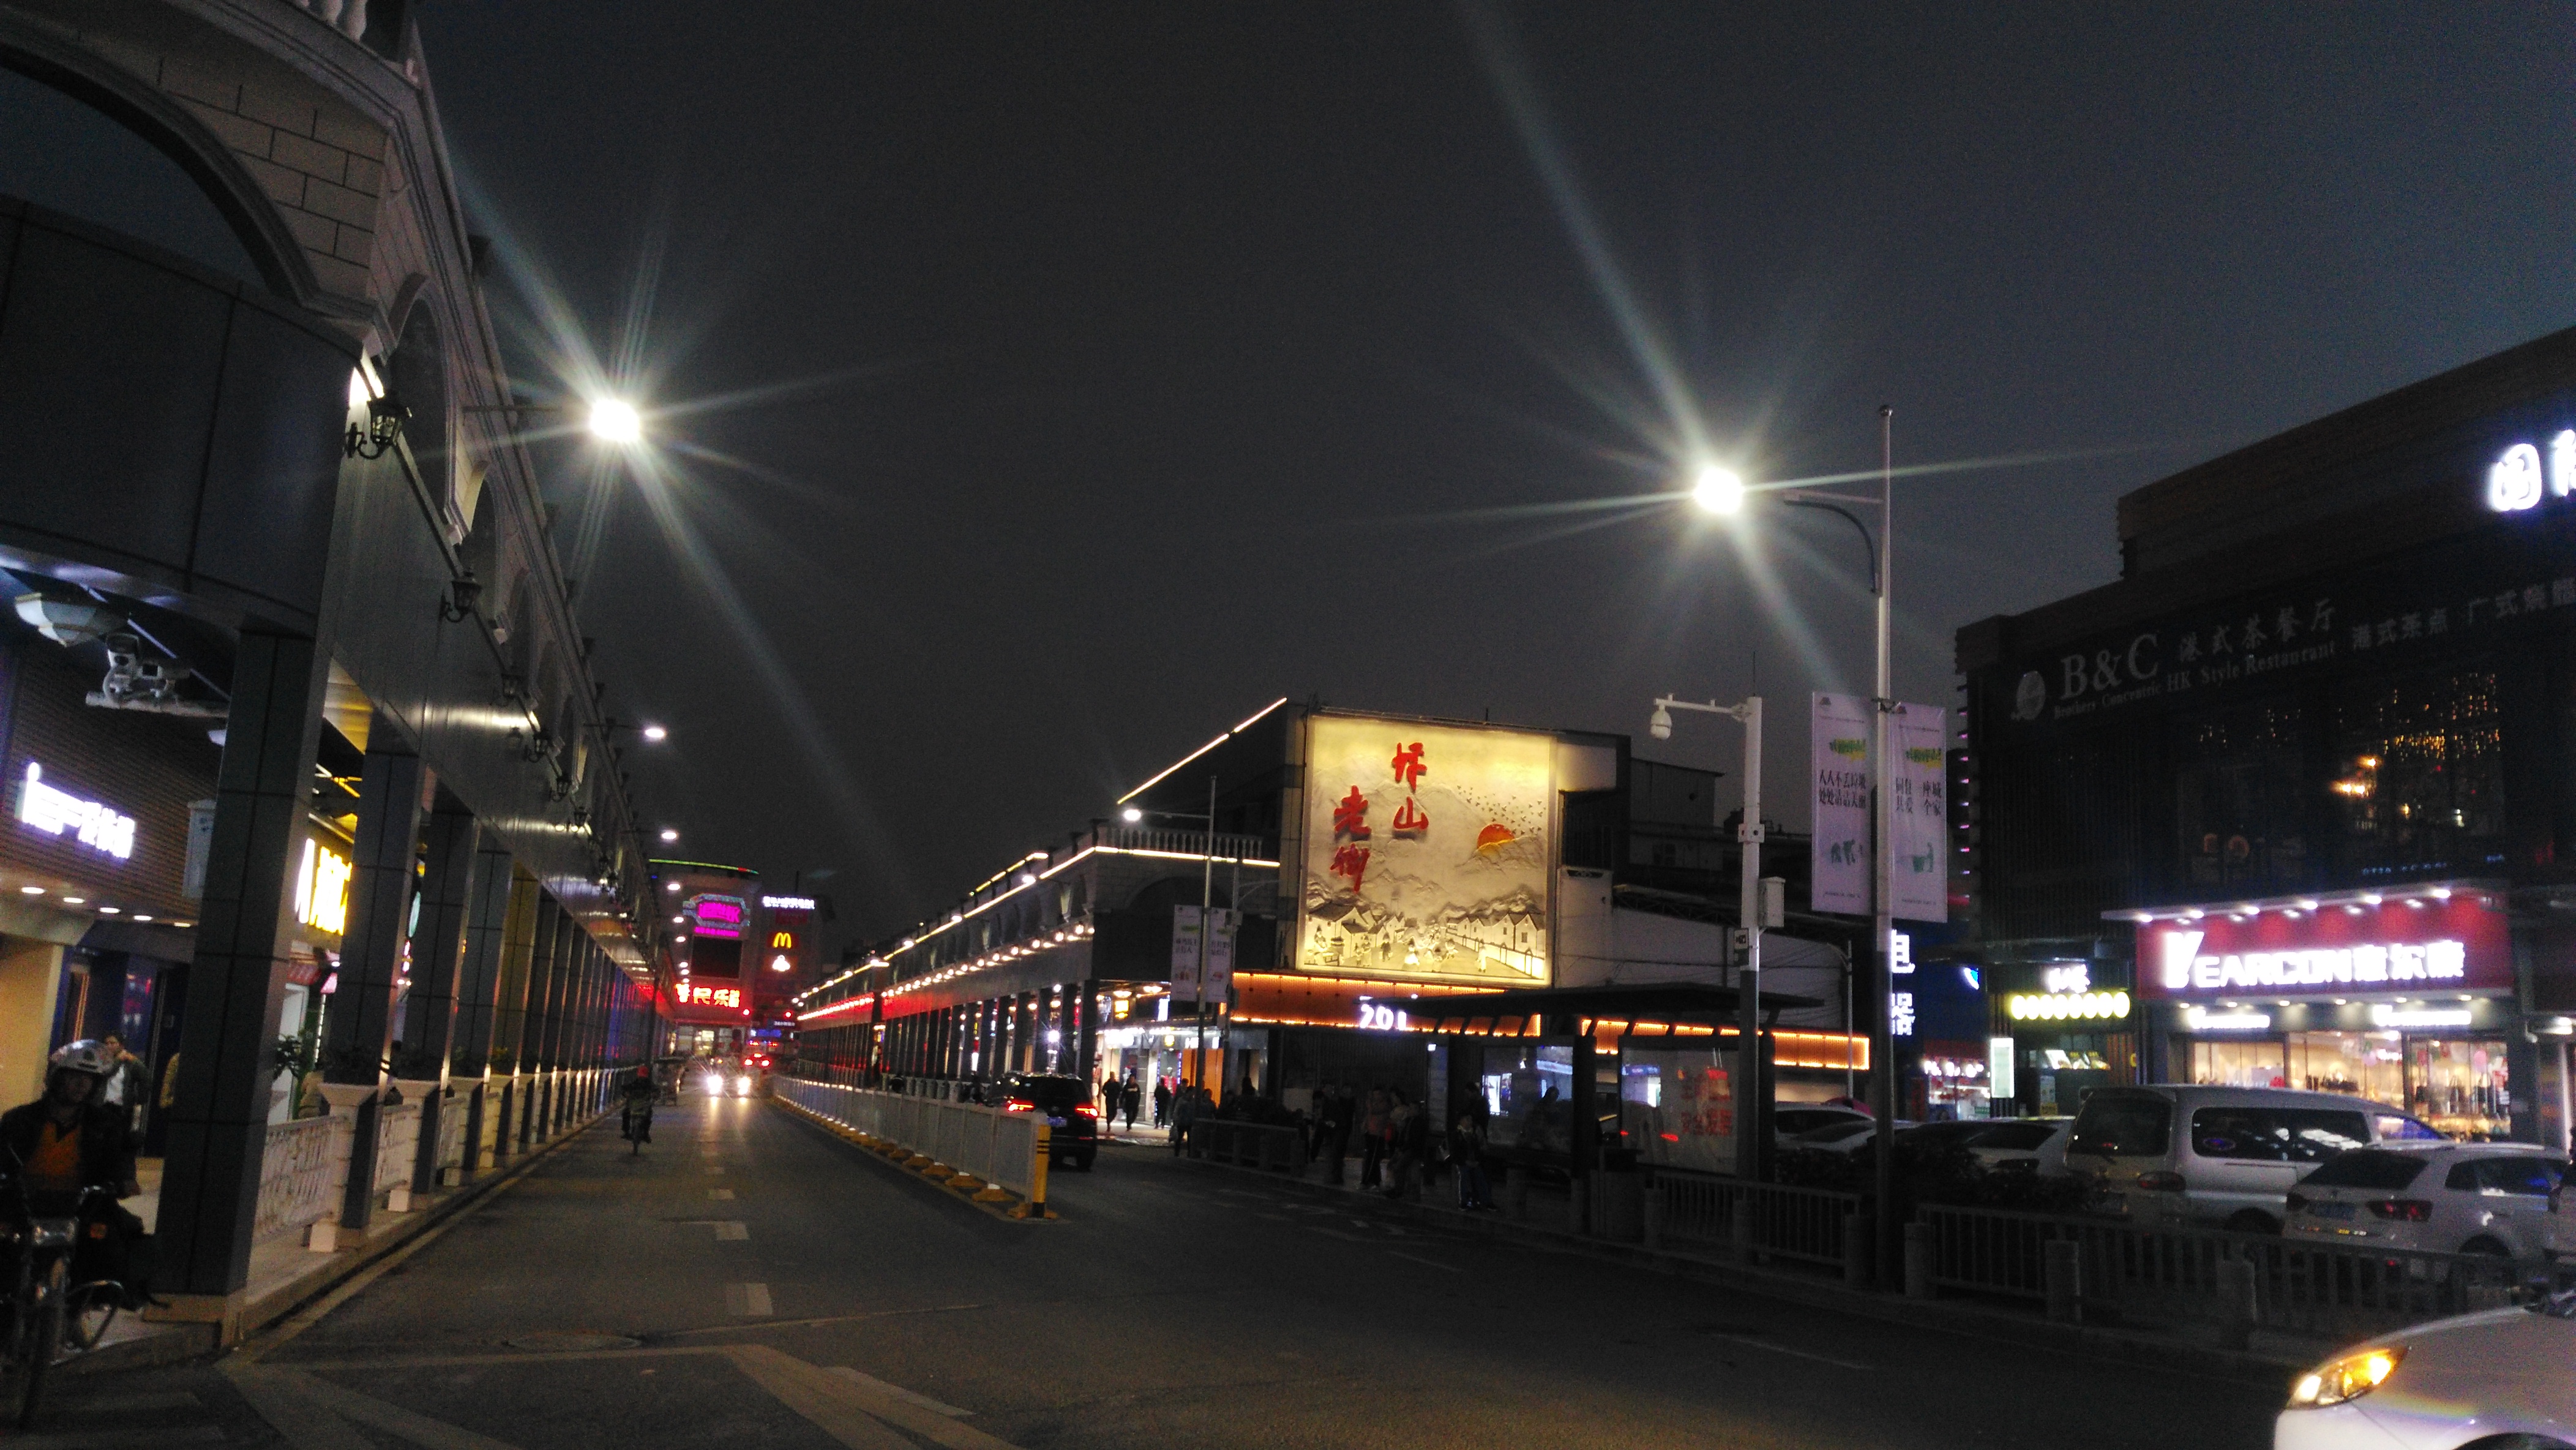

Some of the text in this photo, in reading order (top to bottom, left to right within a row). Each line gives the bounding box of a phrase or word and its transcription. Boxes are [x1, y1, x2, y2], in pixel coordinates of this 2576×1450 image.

[2178, 598, 2336, 663] 港式茶餐厅
[2059, 633, 2160, 701] B&C
[2166, 671, 2193, 694] HK
[2200, 661, 2240, 687] Style
[2245, 639, 2336, 676] Restaurant
[2165, 931, 2352, 988] YEARCON
